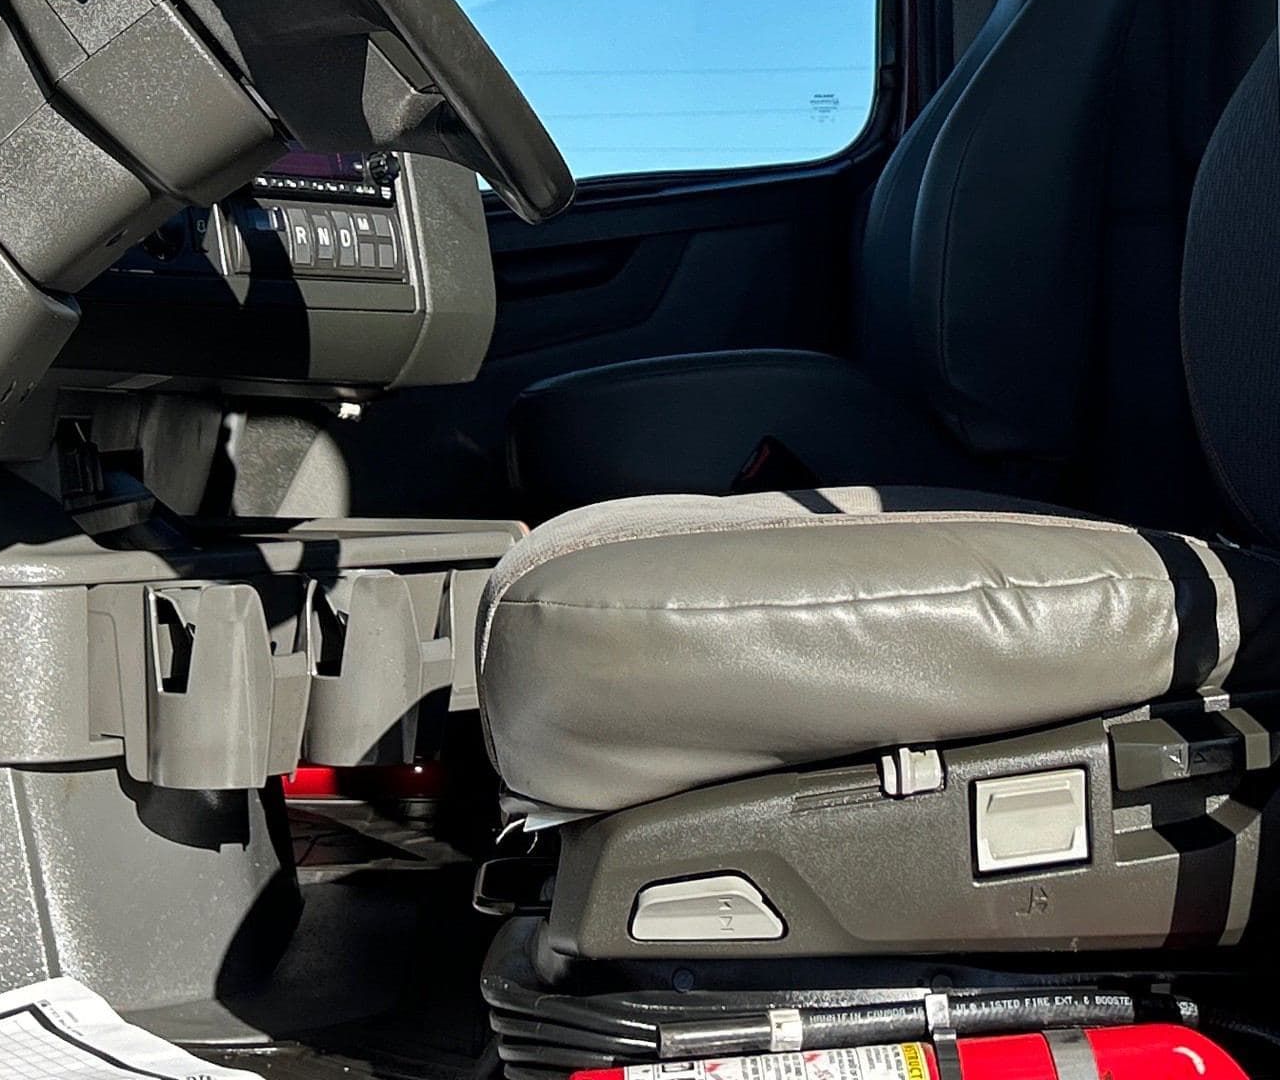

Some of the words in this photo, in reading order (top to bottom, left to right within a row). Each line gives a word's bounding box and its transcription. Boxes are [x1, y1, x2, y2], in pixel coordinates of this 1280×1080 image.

[296, 226, 307, 244] R
[318, 227, 330, 246] N
[340, 230, 351, 247] D
[357, 217, 369, 230] M
[1024, 996, 1050, 1008] FIRE
[1095, 995, 1133, 1006] BOOSTE
